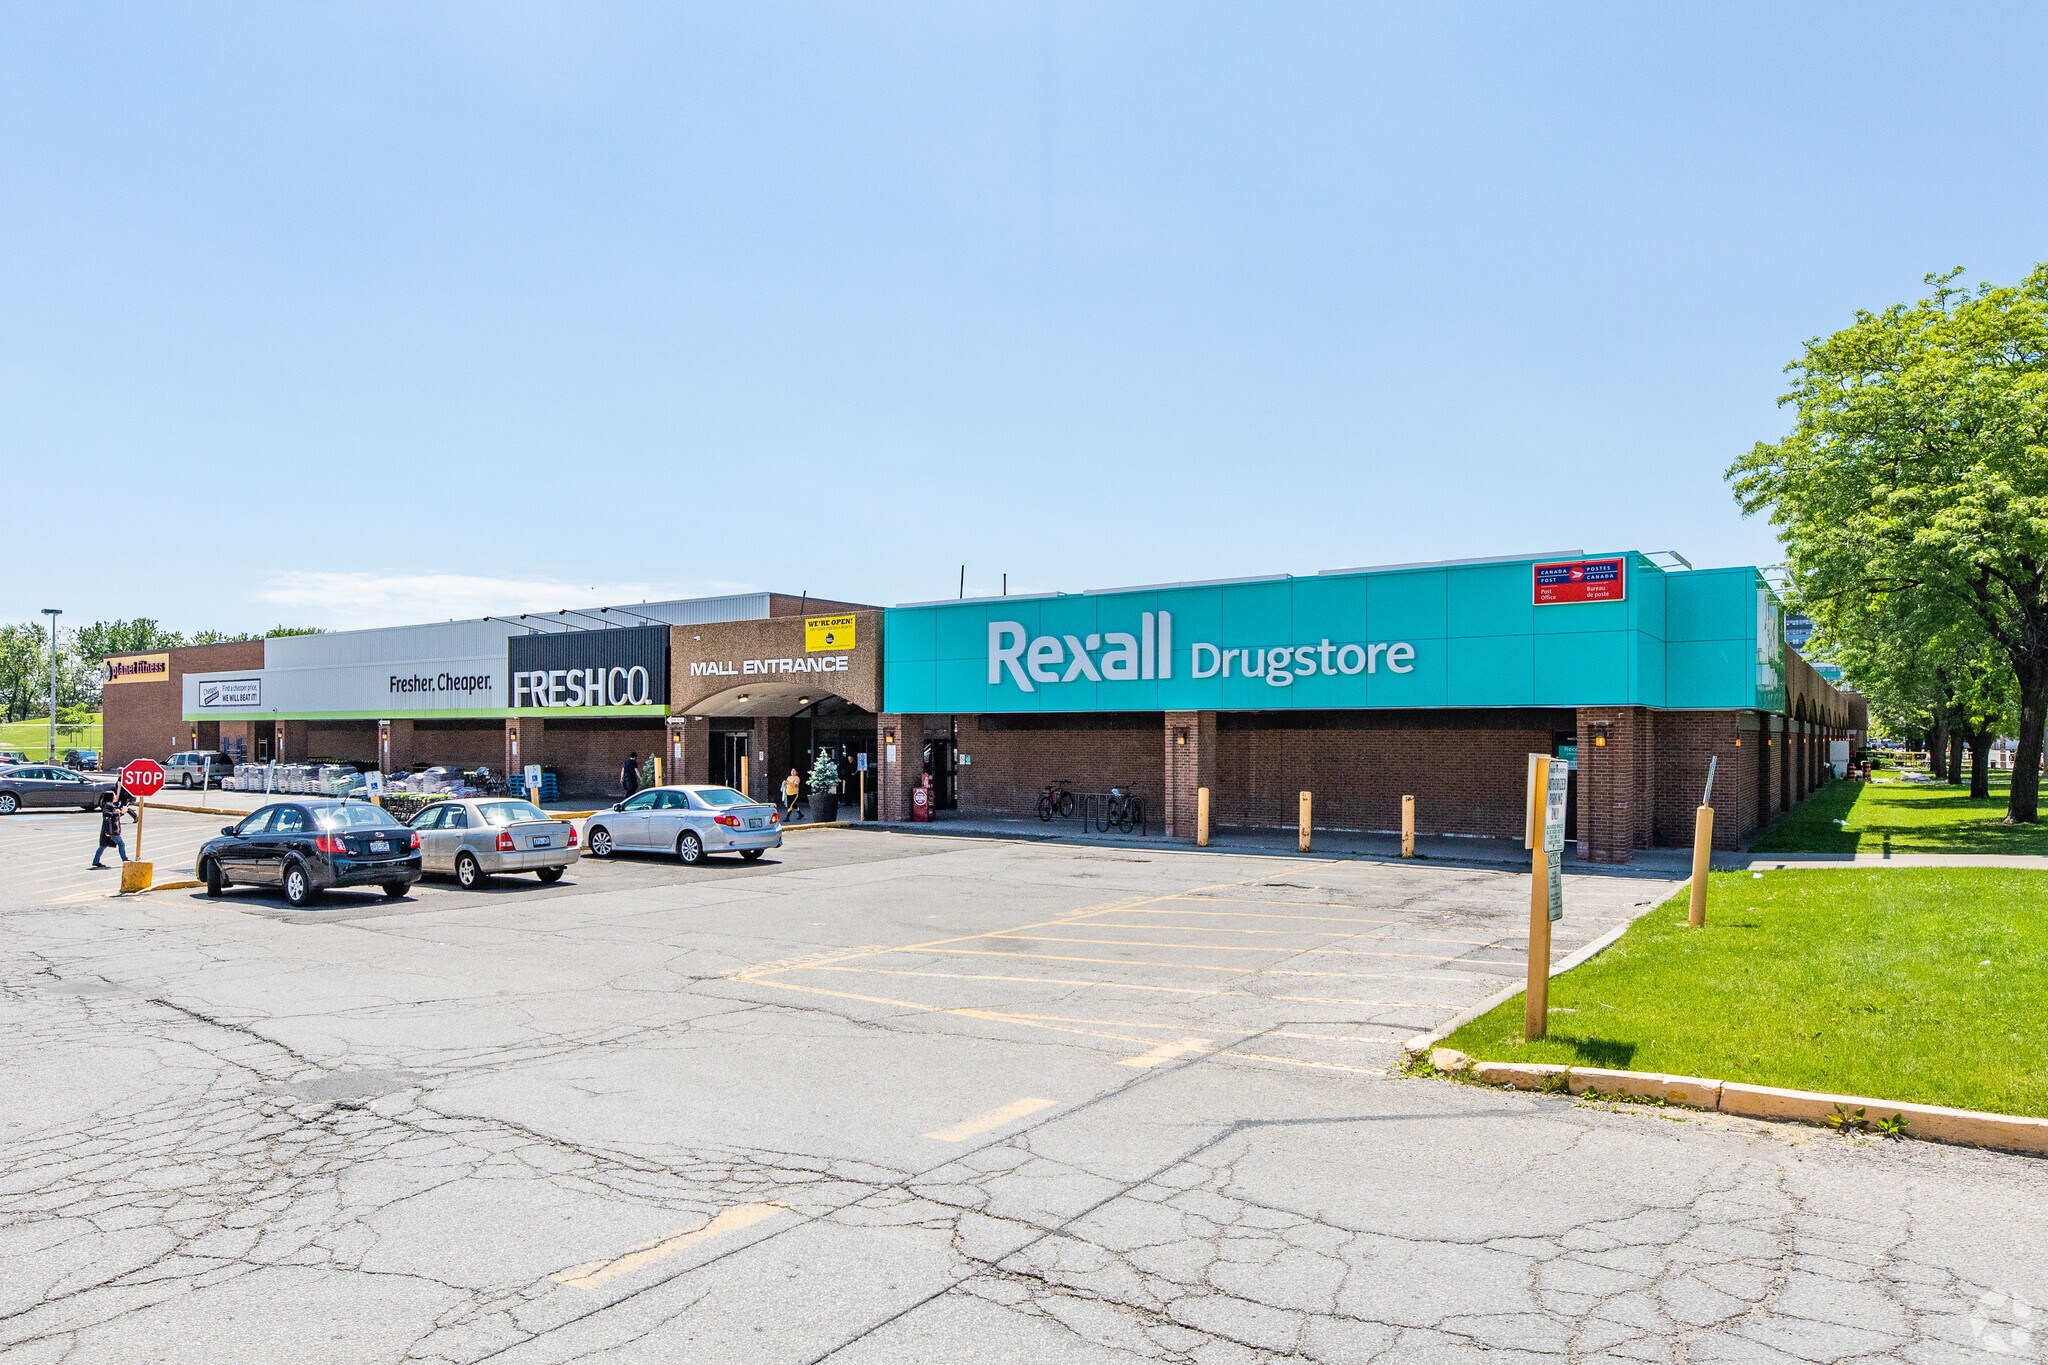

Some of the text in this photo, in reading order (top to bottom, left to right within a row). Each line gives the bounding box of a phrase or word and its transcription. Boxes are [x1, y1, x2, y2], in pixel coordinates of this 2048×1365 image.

[1594, 591, 1610, 599] poste
[988, 610, 1415, 693] Rexall Drugstore
[112, 661, 165, 679] planet fitness
[690, 655, 849, 677] MALL ENTRANCE
[233, 684, 247, 693] cheaper
[389, 672, 492, 695] Fresher. Cheaper.
[125, 771, 163, 786] STOP
